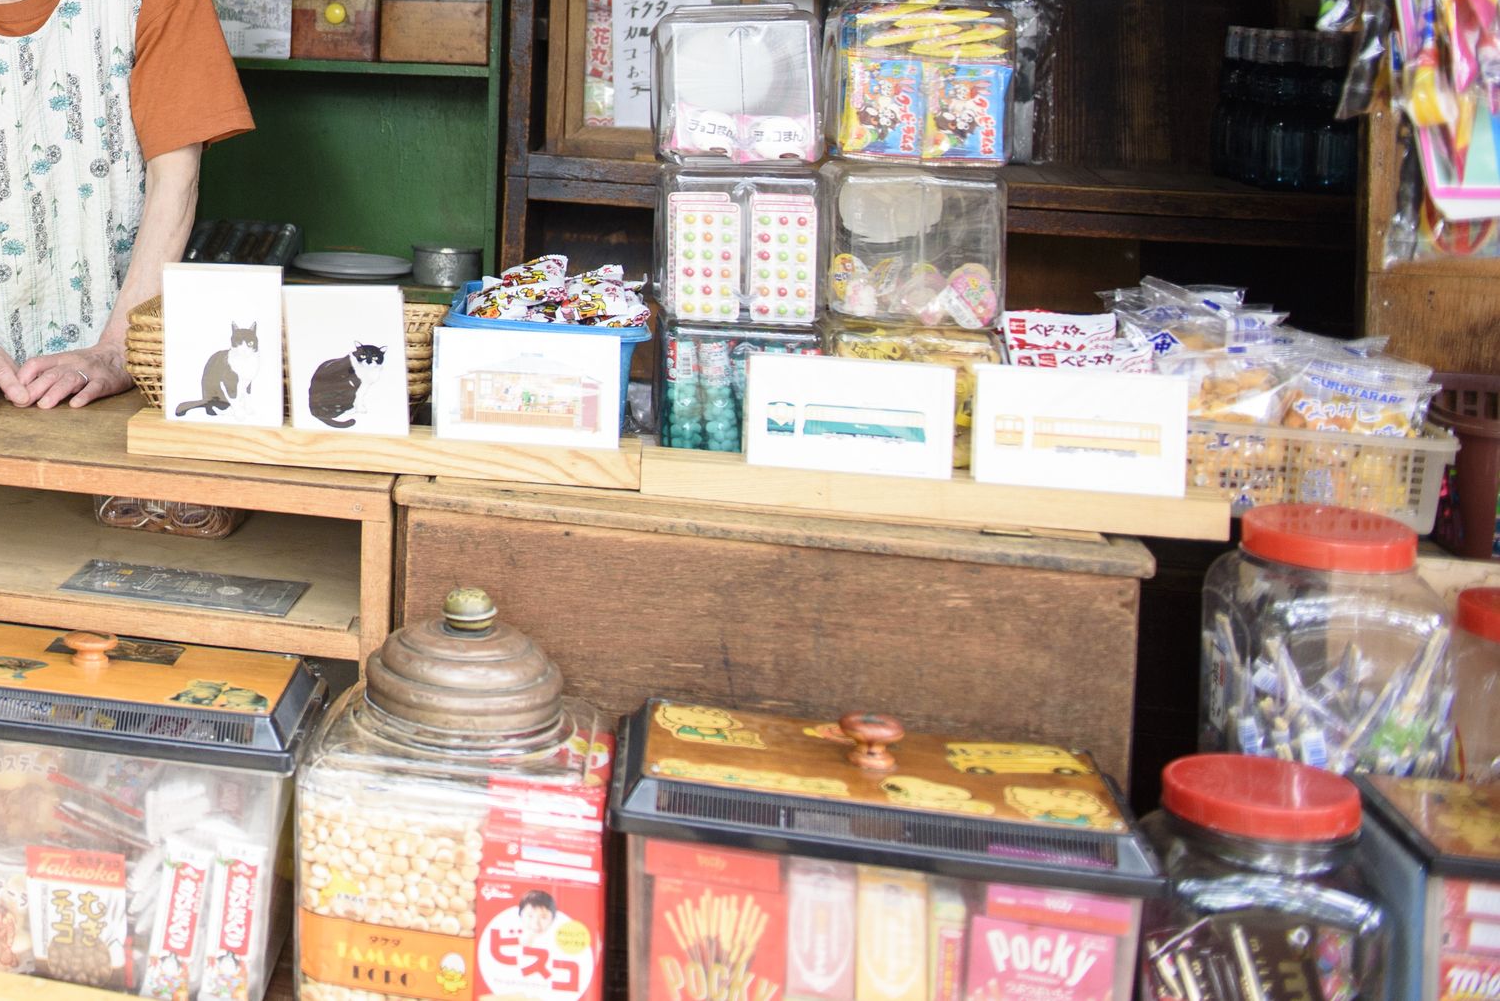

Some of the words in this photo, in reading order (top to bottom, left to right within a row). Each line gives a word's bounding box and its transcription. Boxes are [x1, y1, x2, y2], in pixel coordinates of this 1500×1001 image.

[35, 852, 121, 883] Takaoka
[489, 928, 580, 993] ビスコ
